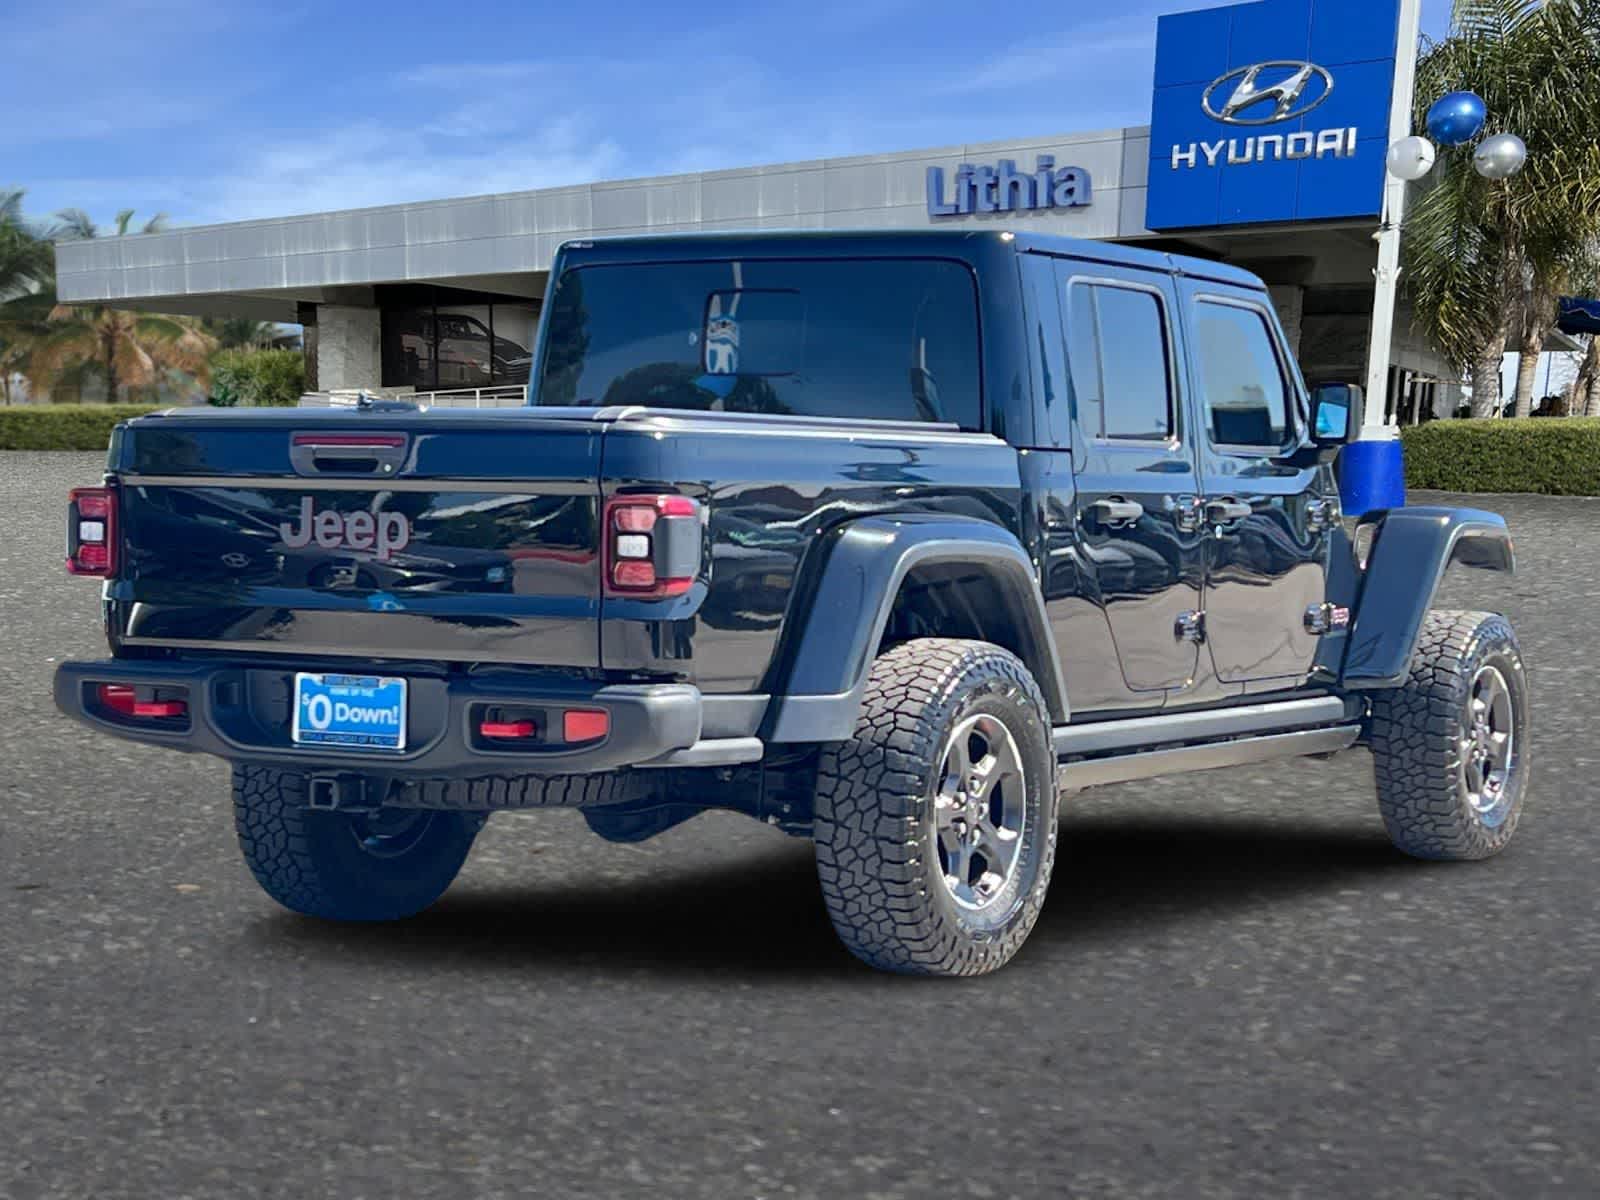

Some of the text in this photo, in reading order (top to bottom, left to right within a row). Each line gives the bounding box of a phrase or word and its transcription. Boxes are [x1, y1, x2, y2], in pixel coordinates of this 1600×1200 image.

[1171, 127, 1358, 169] HYUNDAI
[926, 154, 1093, 217] Lithia
[280, 496, 409, 560] Jeep
[302, 692, 399, 730] $0 Down!
